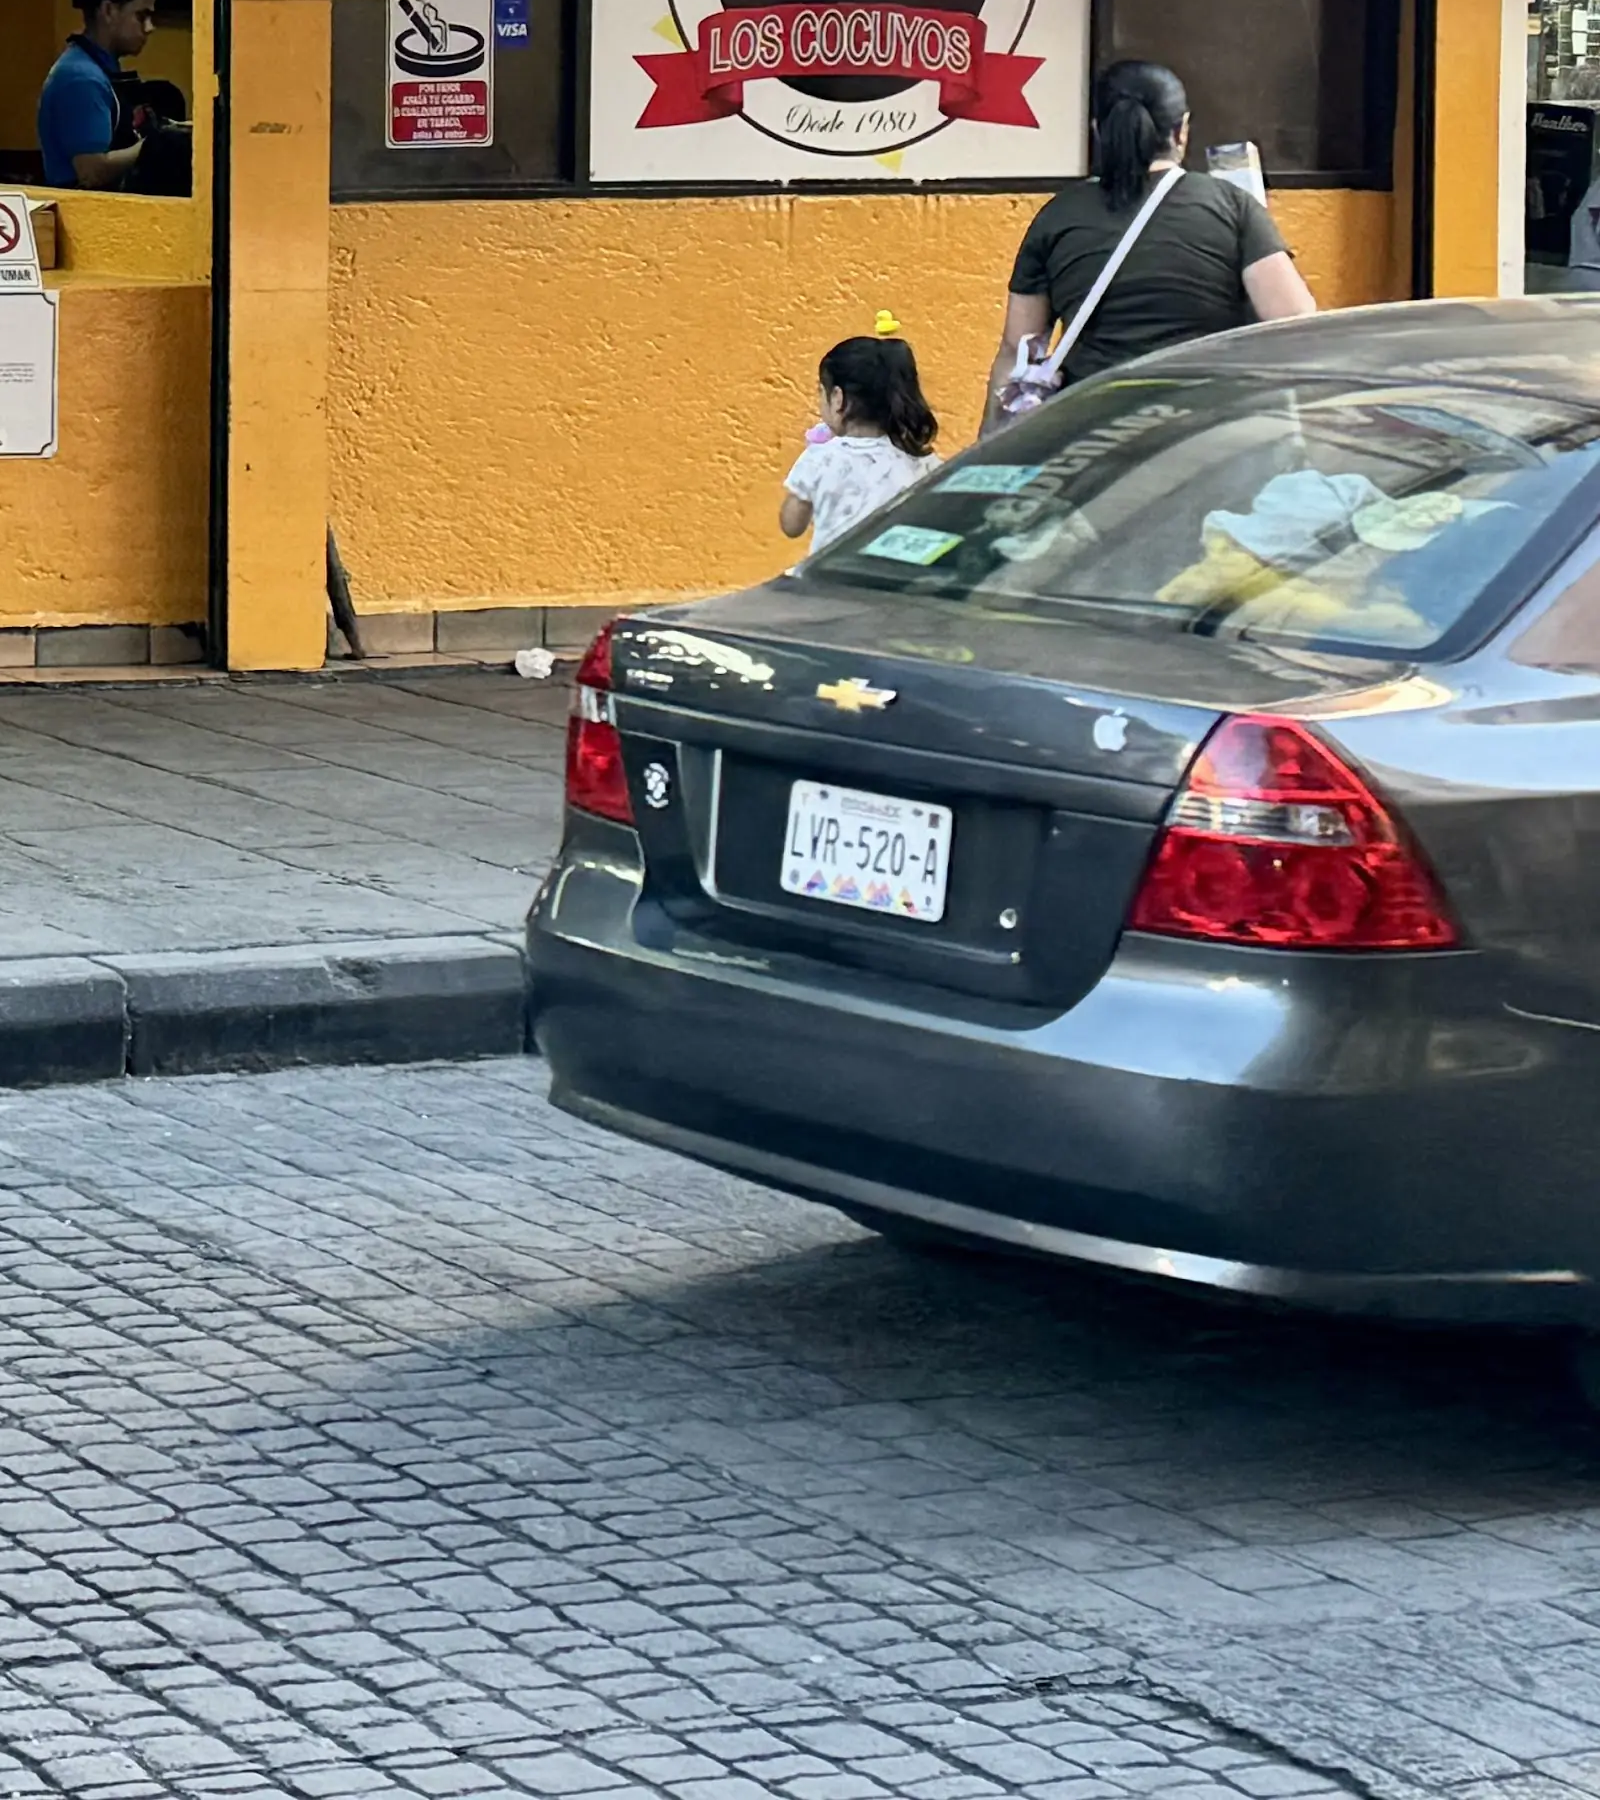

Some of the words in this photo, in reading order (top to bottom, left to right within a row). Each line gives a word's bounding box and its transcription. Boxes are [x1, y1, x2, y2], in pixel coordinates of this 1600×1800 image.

[497, 23, 528, 37] VISA
[709, 13, 784, 74] LOS
[791, 8, 972, 74] COCUYOS
[784, 104, 846, 135] Desde
[854, 108, 918, 134] 1980
